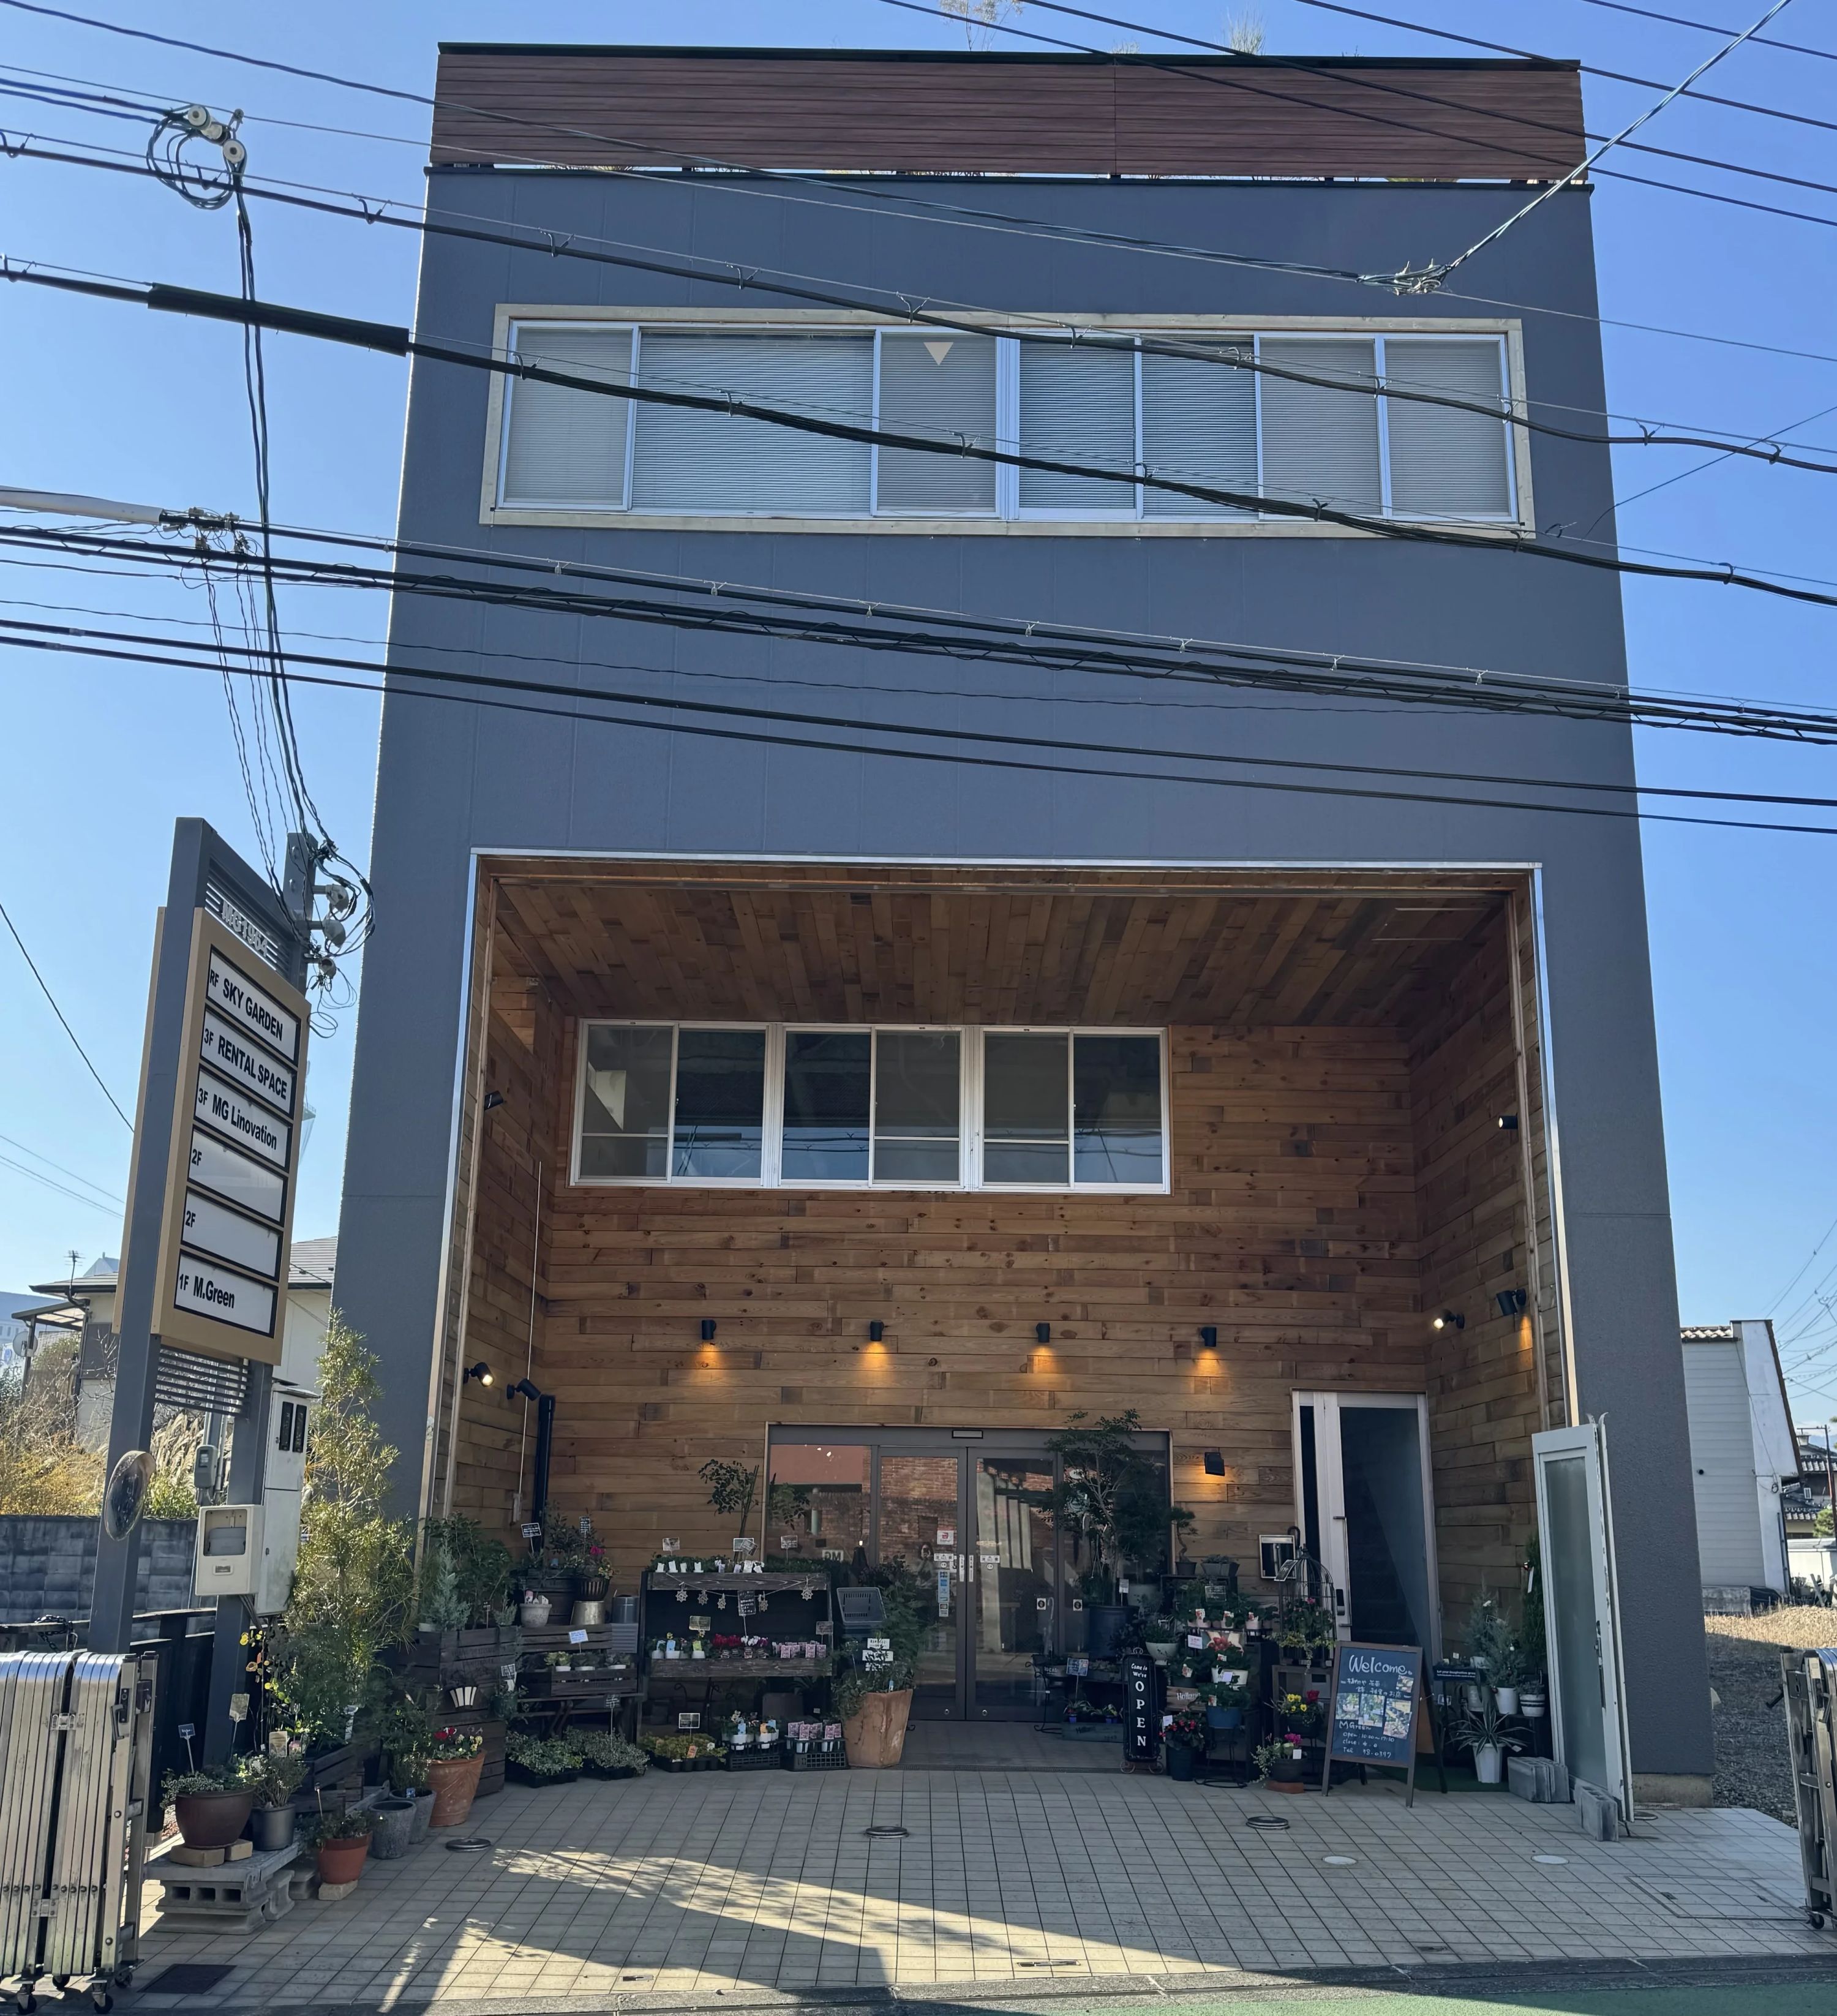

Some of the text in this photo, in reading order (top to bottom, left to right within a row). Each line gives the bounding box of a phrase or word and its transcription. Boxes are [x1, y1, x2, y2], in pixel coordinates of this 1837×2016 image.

[209, 969, 282, 1042] RF SKY GARDEN
[204, 1028, 287, 1100] 3F RENTAL SPACE
[198, 1087, 277, 1151] 3F MG Linovation
[191, 1148, 202, 1166] 2F
[186, 1210, 196, 1228] 2F
[179, 1274, 235, 1309] 1F M.Green
[1135, 1680, 1146, 1747] OPEN
